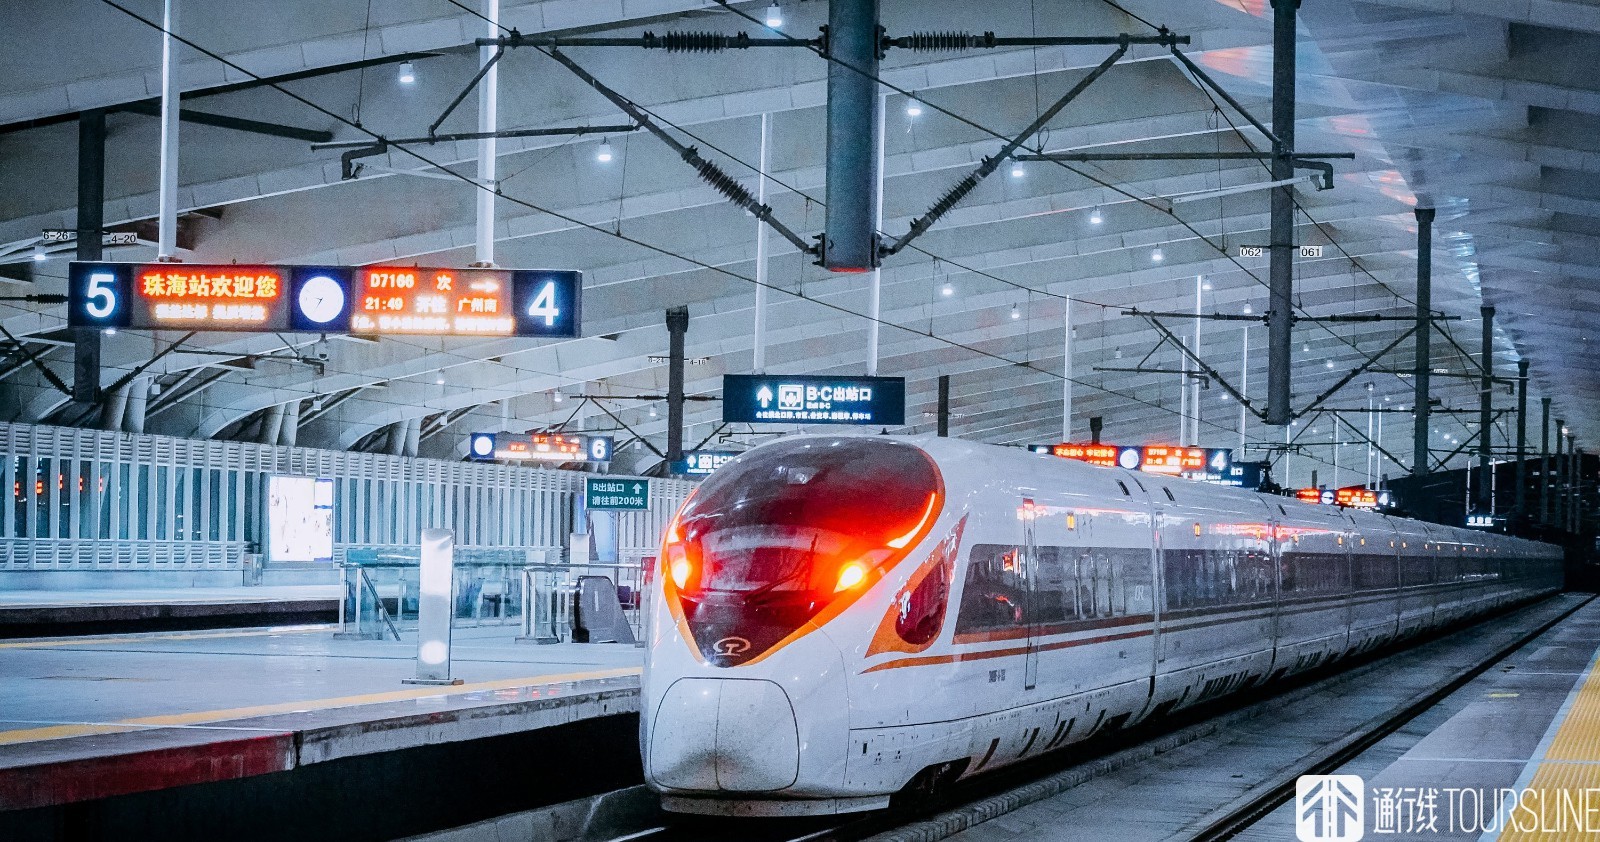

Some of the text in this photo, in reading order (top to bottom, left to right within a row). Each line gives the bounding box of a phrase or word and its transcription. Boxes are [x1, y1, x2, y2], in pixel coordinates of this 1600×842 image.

[43, 232, 69, 240] 6-26
[111, 234, 137, 244] 4-20
[1241, 248, 1262, 257] 062
[1301, 247, 1320, 257] 061
[142, 273, 278, 298] 珠海站欢迎您
[436, 275, 452, 291] 次
[86, 274, 116, 318] 5
[528, 281, 560, 326] 4
[457, 298, 498, 313] 广州南
[592, 440, 606, 459] 6
[1211, 452, 1225, 471] 4
[592, 482, 625, 492] B出站口
[592, 495, 644, 506] 请往前200米
